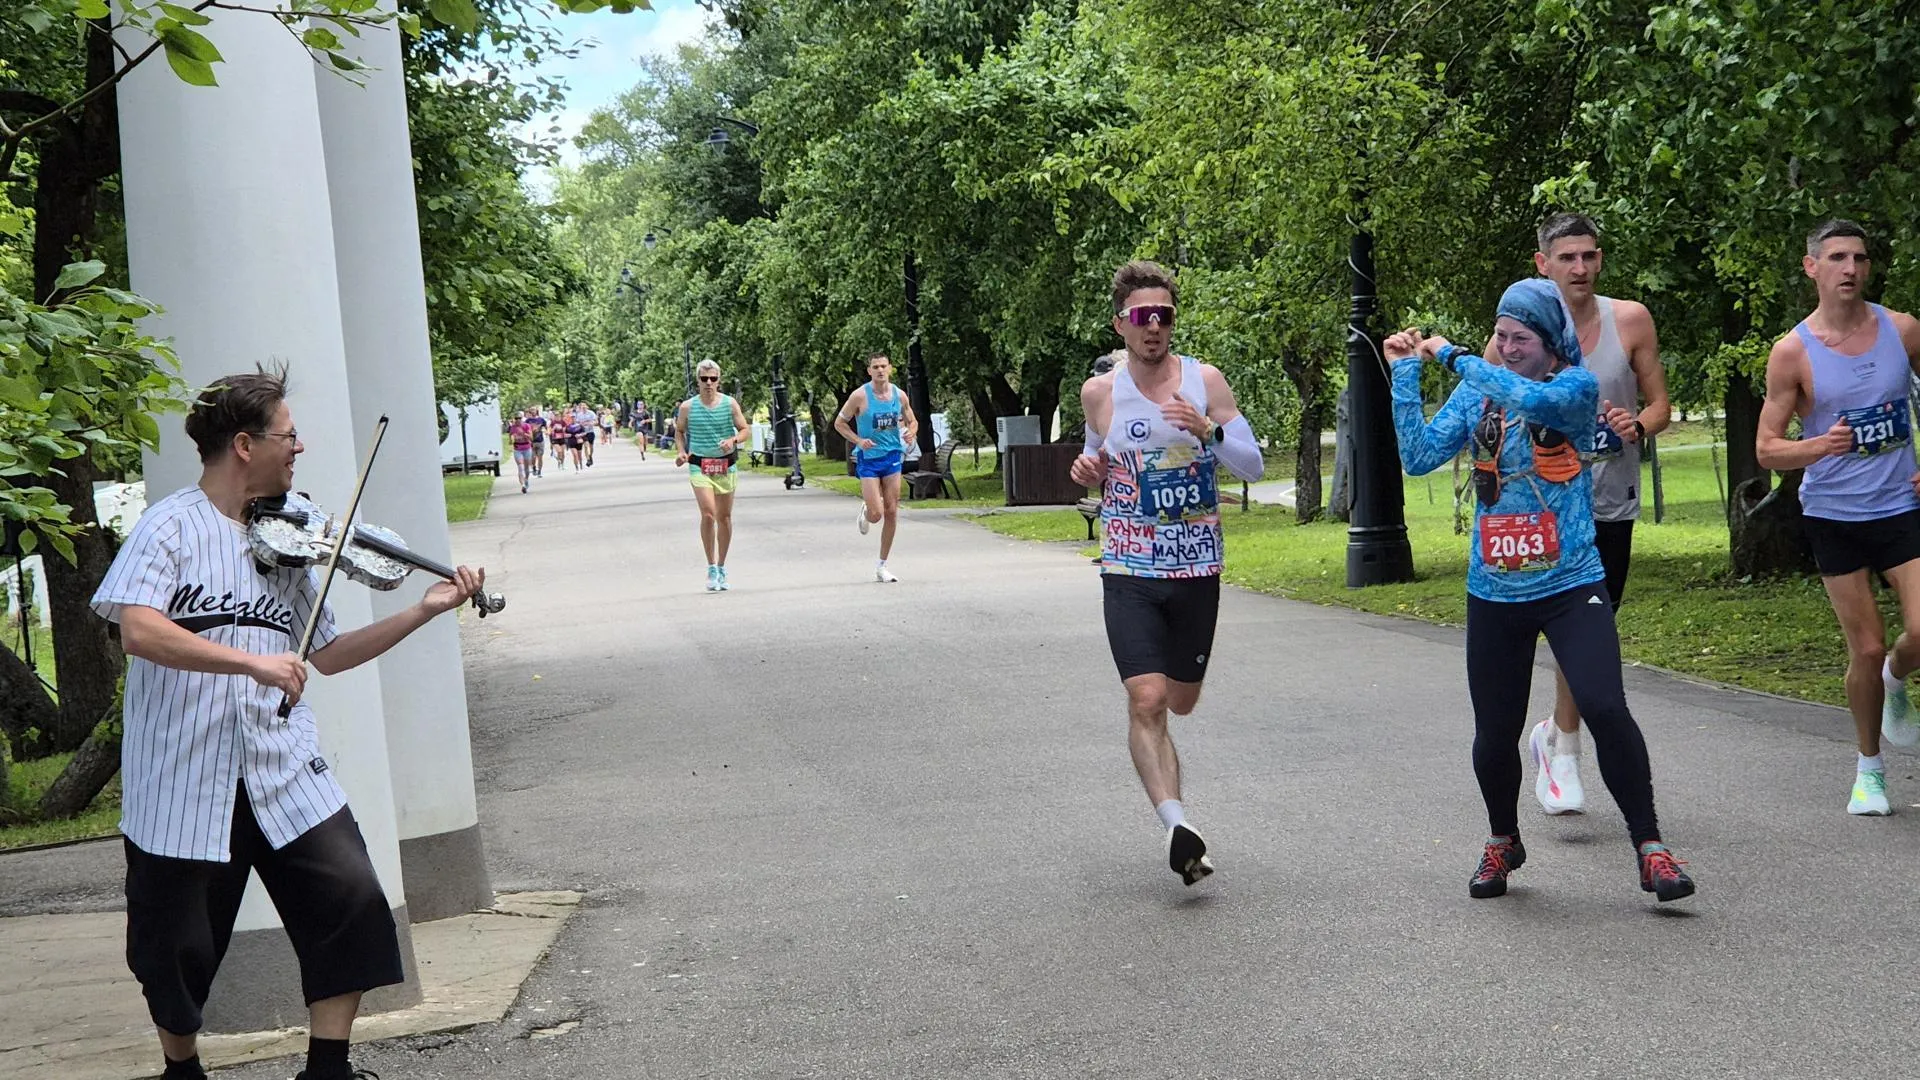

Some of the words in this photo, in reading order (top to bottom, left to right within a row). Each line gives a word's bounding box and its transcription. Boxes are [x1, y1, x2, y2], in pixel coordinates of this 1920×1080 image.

[1854, 419, 1895, 445] 1231
[1151, 484, 1201, 509] 1093
[1489, 533, 1545, 558] 2063
